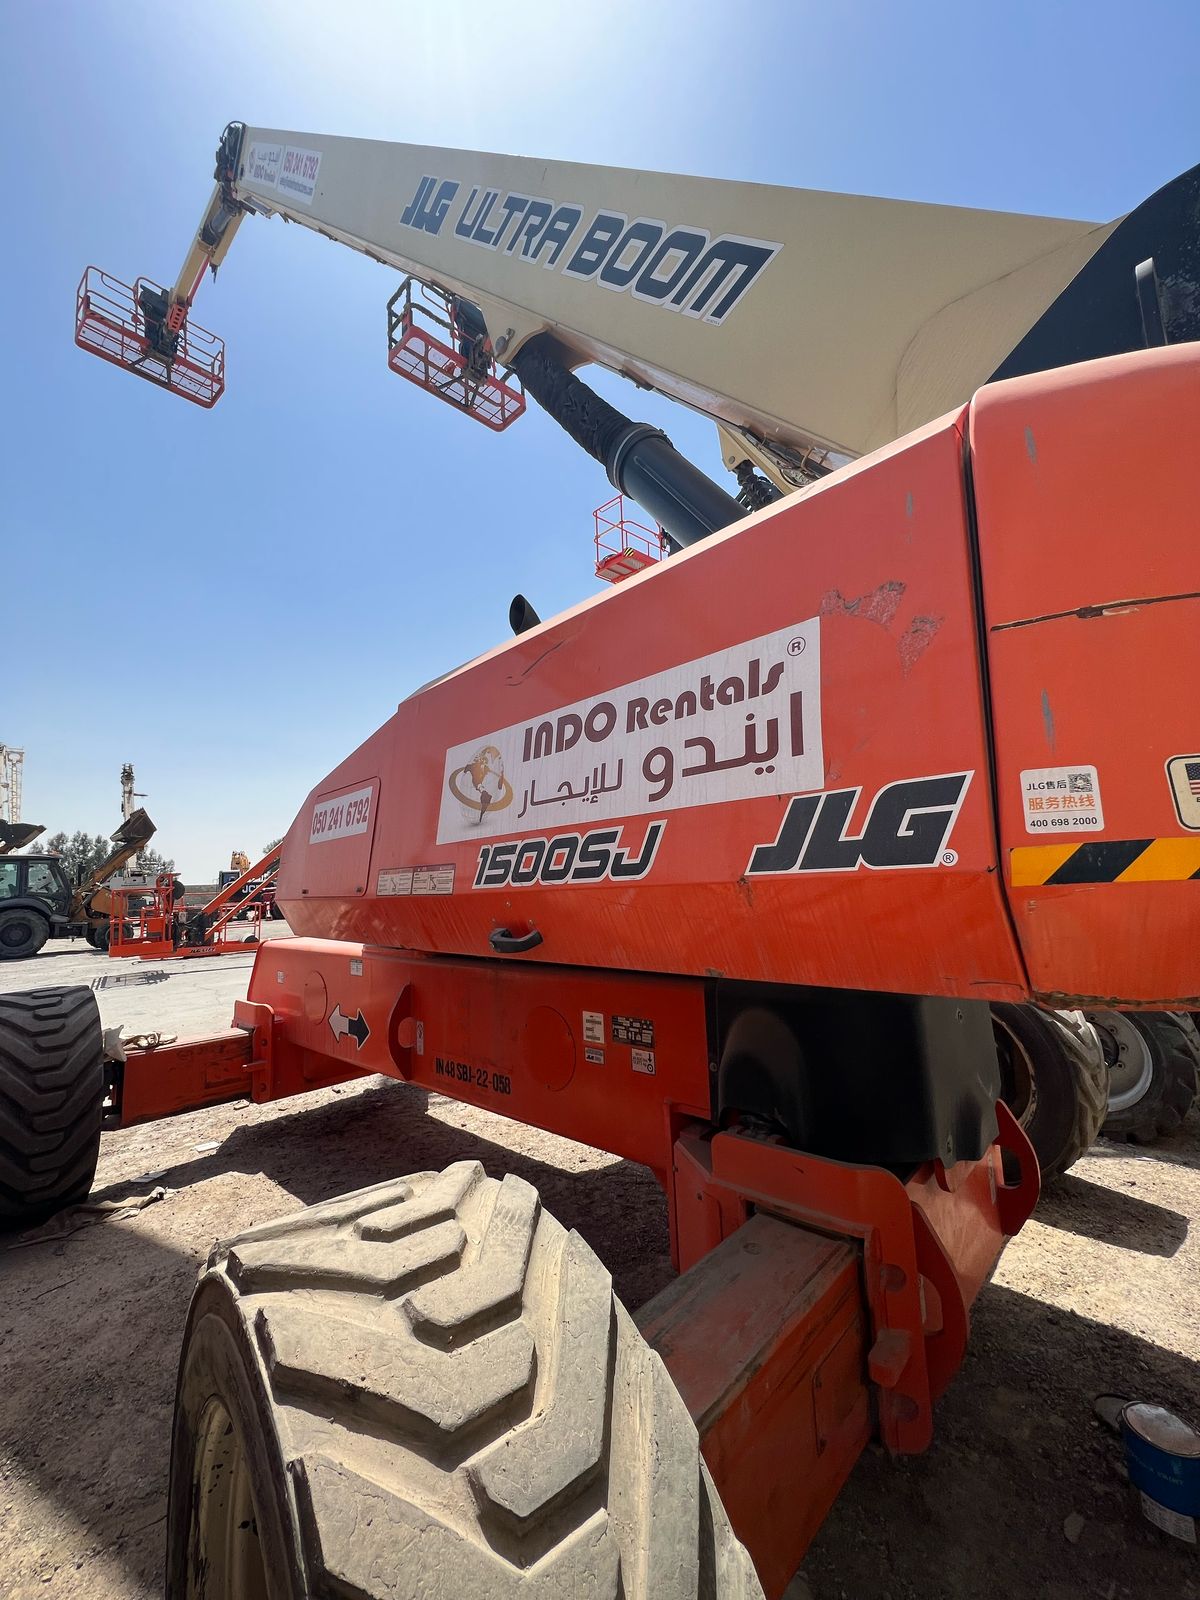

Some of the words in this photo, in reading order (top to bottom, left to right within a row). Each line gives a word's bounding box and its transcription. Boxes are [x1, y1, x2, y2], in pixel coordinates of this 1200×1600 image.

[400, 176, 460, 237] JLG
[455, 184, 584, 270] ULTRA
[564, 211, 781, 323] BOOM
[523, 701, 617, 762] INDO
[626, 658, 784, 733] Rentals
[642, 690, 805, 802] ايندو
[312, 809, 328, 835] 050
[327, 805, 345, 831] 241
[345, 796, 370, 827] 6792
[745, 771, 973, 874] JLG
[1028, 794, 1096, 811] 服务热线
[1030, 819, 1048, 828] 400
[1051, 818, 1070, 827] 698
[1072, 816, 1098, 826] 2000
[474, 821, 666, 888] 1500SJ
[242, 884, 261, 894] JC
